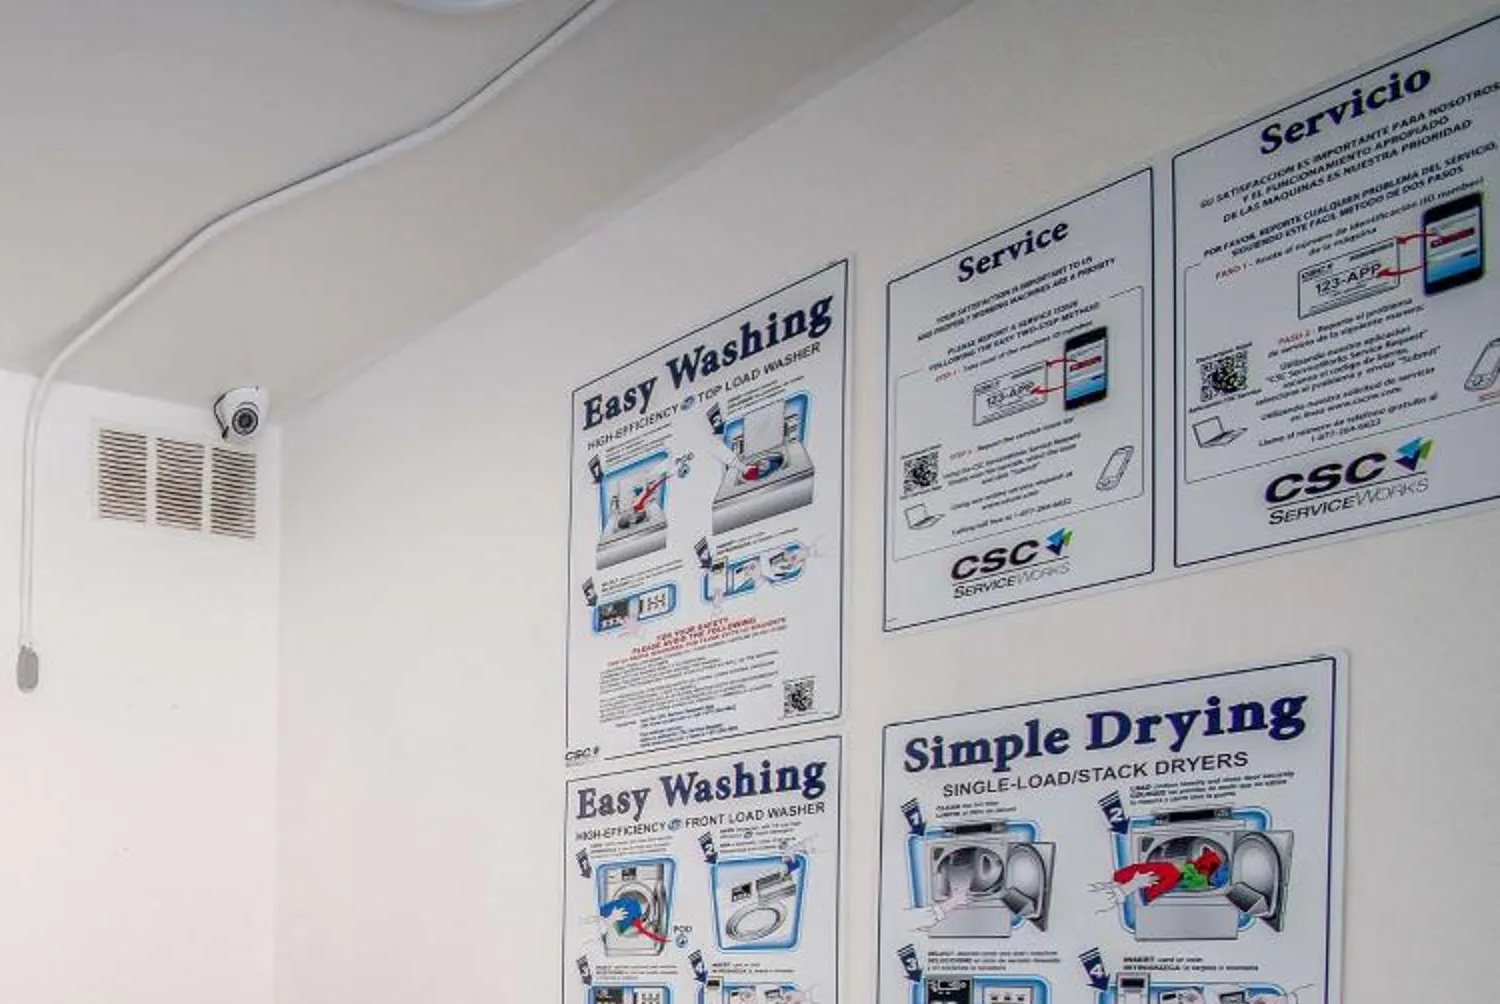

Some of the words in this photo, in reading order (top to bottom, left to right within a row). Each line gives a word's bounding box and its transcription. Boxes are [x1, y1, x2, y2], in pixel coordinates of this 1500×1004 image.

[1259, 68, 1431, 155] Servicio
[1297, 155, 1312, 170] ES
[1314, 124, 1388, 163] IMPORTANTE
[1392, 109, 1425, 132] PARA
[1223, 209, 1238, 223] DE
[1239, 201, 1260, 217] LAS
[1343, 146, 1397, 176] NUESTRA
[1401, 117, 1472, 154] PRIORIDAD
[1242, 193, 1248, 204] Y
[1251, 188, 1261, 200] EL
[1265, 144, 1370, 194] FUNCIONAMIENTO
[1375, 113, 1448, 151] APROPIADO
[1427, 163, 1463, 184] PASOS
[1203, 243, 1222, 258] POR
[1362, 168, 1419, 198] PROBLEMA
[1421, 159, 1441, 176] DEL
[957, 222, 1069, 283] Service
[1316, 261, 1380, 294] 123-APP
[582, 376, 658, 431] Easy
[665, 295, 834, 390] Washing
[587, 404, 679, 451] HIGH-EFFICIENCY
[697, 383, 724, 403] TOP
[725, 367, 761, 392] LOAD
[763, 341, 822, 376] WASHER
[1265, 452, 1386, 504] CSC
[951, 539, 1039, 581] CSC
[904, 719, 1070, 774] Simple
[1085, 696, 1308, 752] Drying
[575, 787, 650, 822] Easy
[660, 760, 827, 808] Washing
[942, 763, 1148, 798] SINGLE-LOAD/STACK
[1156, 751, 1250, 777] DRYERS
[576, 821, 666, 841] HIGH-EFFICIENCY
[685, 814, 725, 829] FRONT
[729, 808, 764, 824] LOAD
[767, 801, 826, 819] WASHER
